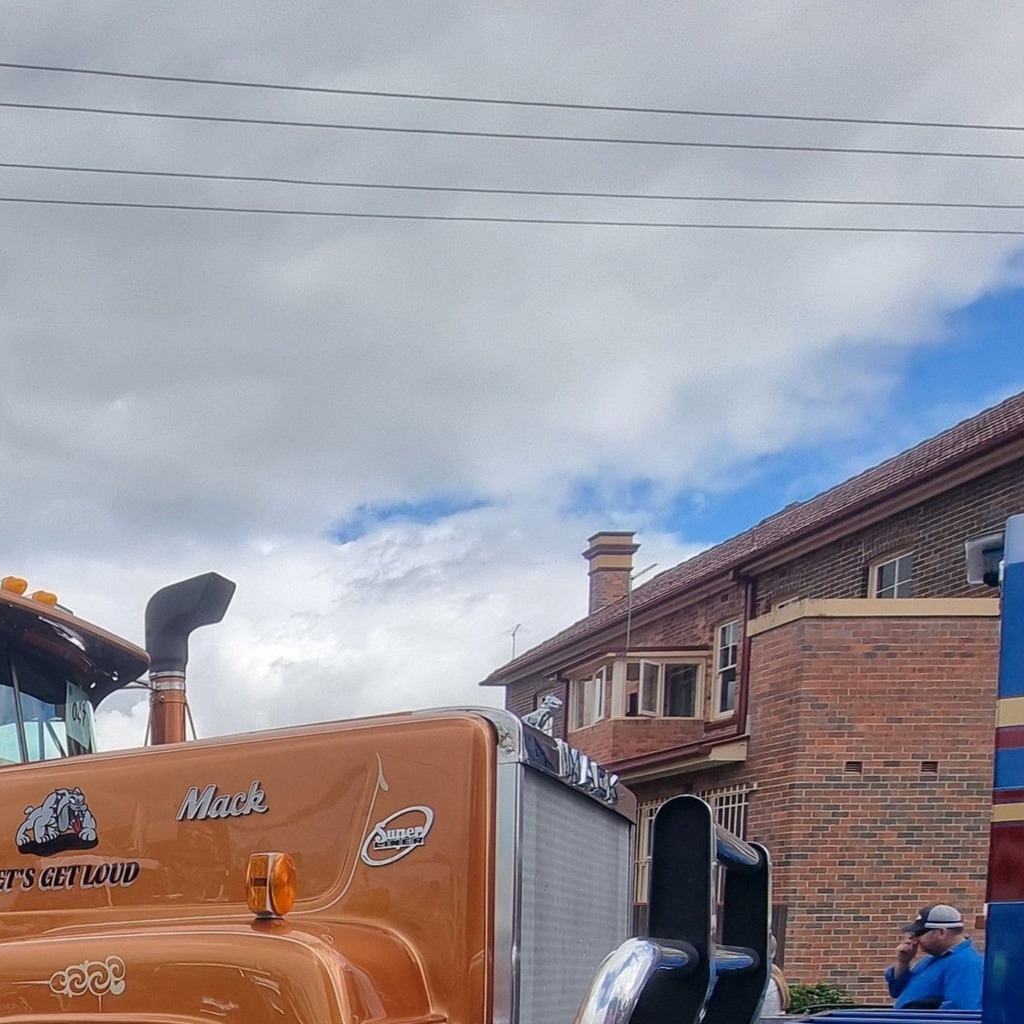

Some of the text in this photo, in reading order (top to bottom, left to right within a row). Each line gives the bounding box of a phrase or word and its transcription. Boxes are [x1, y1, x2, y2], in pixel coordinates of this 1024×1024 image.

[176, 780, 269, 820] Mack
[39, 865, 80, 891] GET
[80, 861, 140, 889] LOUD
